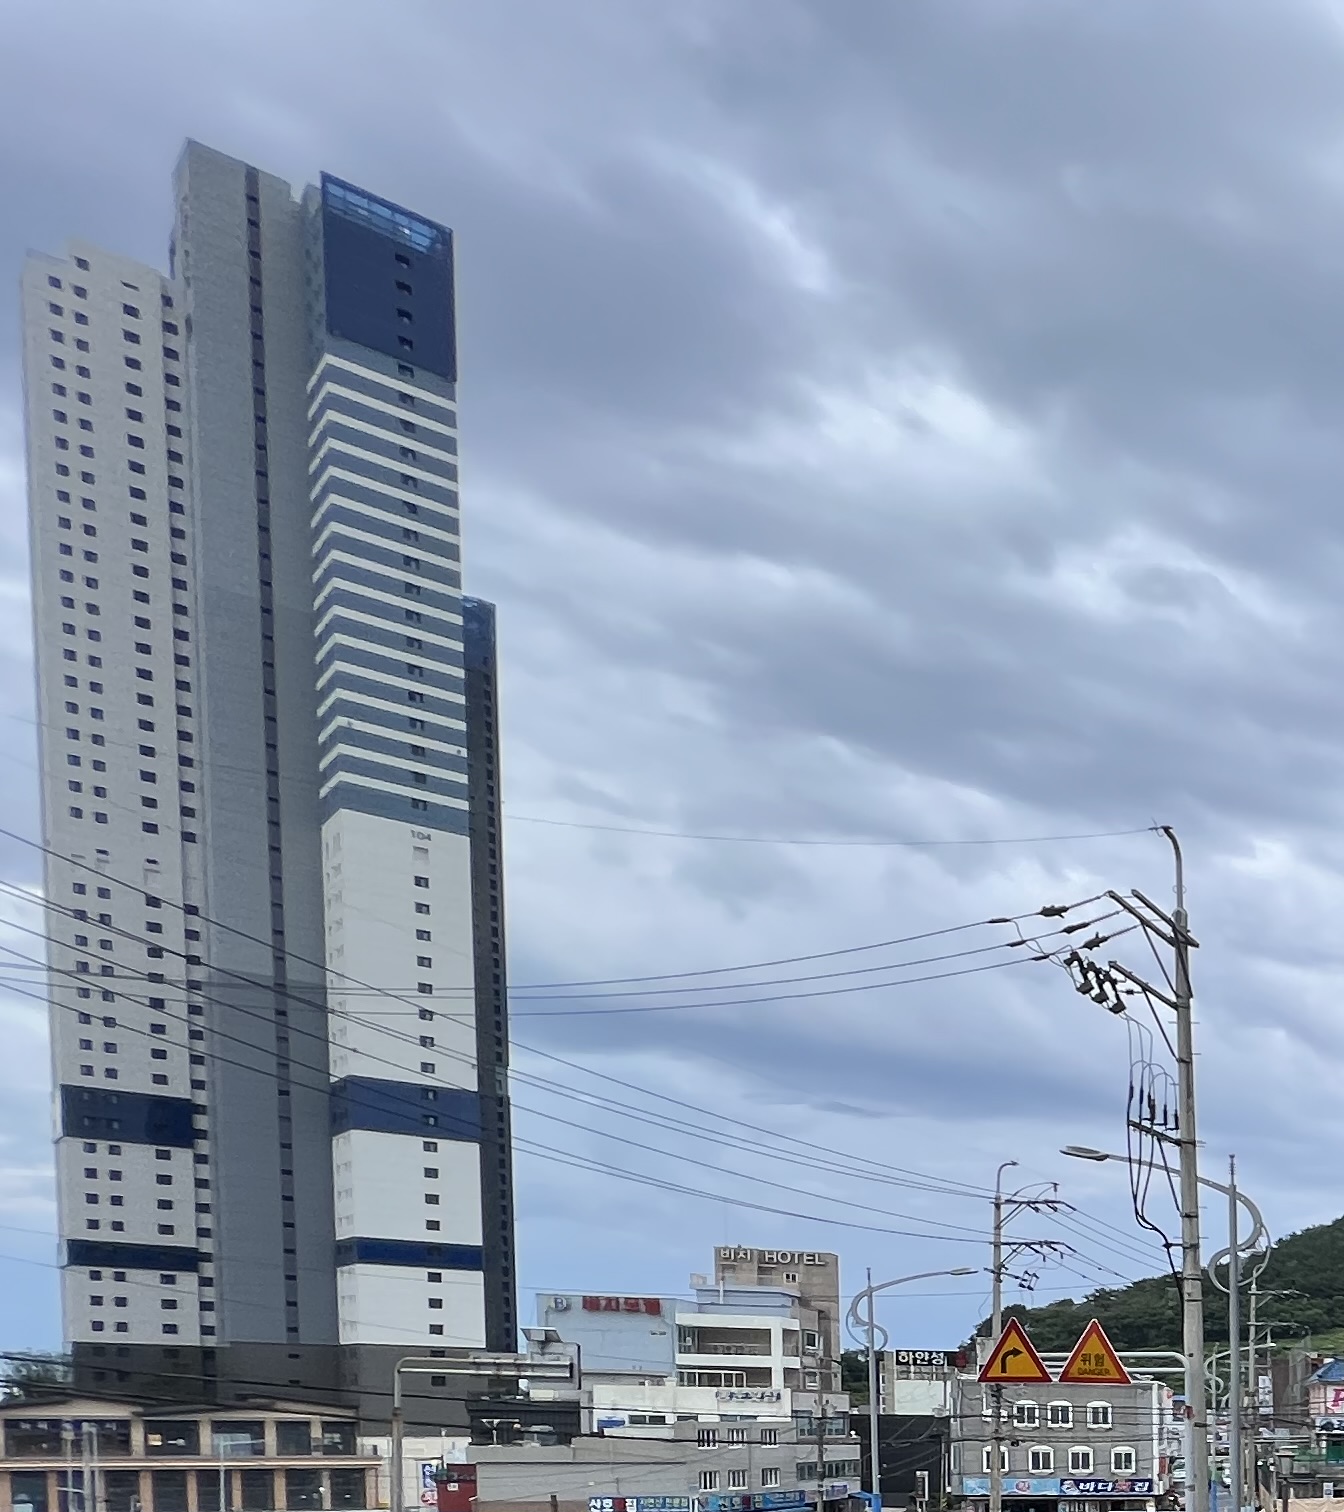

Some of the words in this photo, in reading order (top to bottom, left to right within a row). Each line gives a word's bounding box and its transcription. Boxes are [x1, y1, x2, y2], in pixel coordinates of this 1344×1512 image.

[720, 1248, 751, 1261] 비치
[764, 1250, 825, 1266] HOTEL
[1080, 1352, 1105, 1367] 위험
[589, 1498, 637, 1512] 산호집
